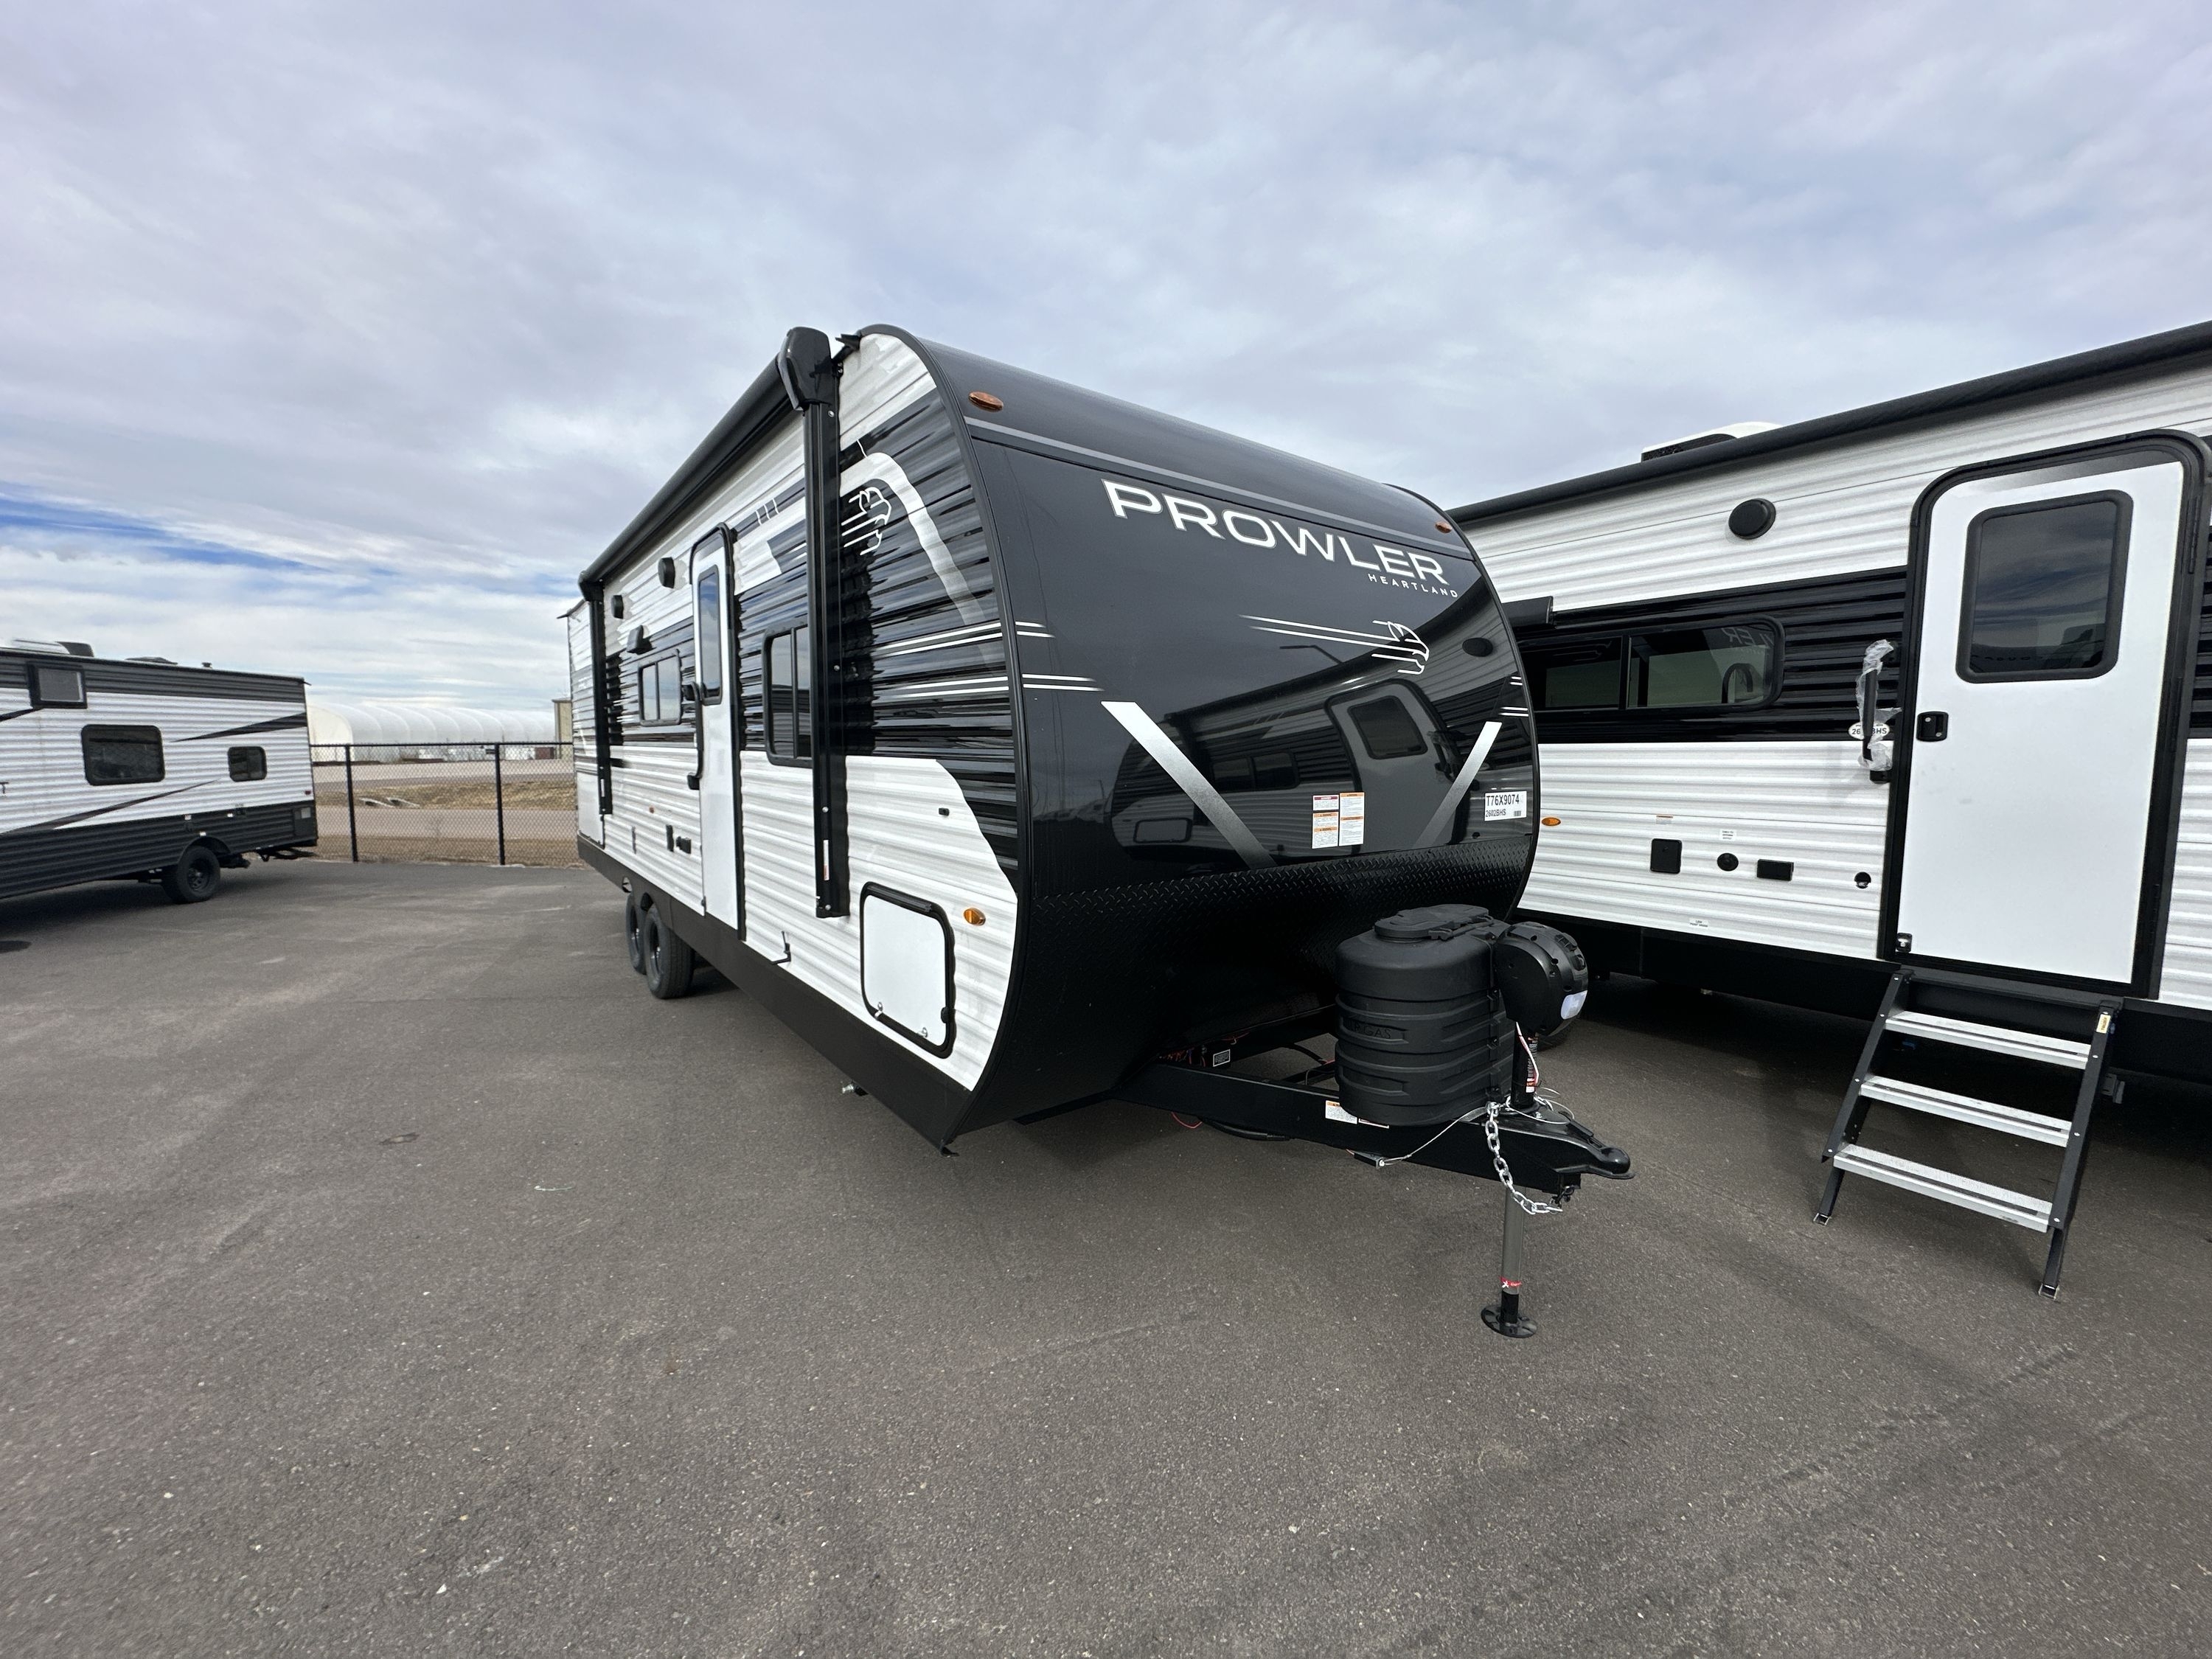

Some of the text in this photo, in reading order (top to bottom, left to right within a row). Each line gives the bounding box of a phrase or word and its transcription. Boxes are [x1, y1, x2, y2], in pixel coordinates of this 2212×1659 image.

[1101, 479, 1450, 585] PROWLER
[1368, 573, 1458, 598] HEARTLAND
[1851, 727, 1888, 735] 26BHS
[1486, 793, 1520, 806] T76X9074
